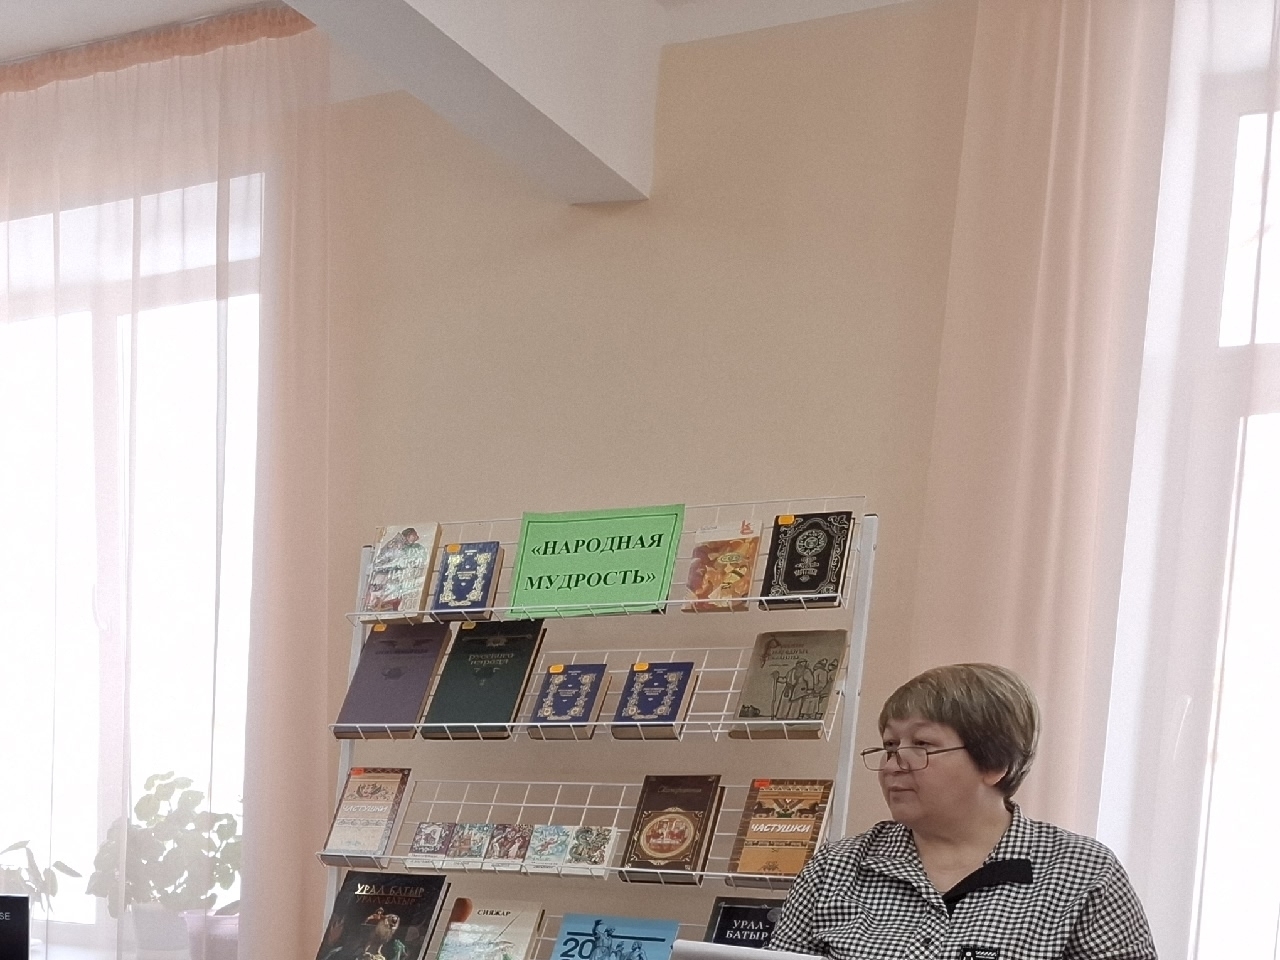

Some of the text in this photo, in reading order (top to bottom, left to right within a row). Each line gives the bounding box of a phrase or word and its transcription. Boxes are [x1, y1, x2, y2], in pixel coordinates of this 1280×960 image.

[531, 533, 664, 556] «НАРОДНАЯ
[523, 569, 656, 591] МУДРОСТЬ»
[750, 823, 812, 833] ЧАСТУШКИ
[732, 919, 770, 930] УРАЛ-
[725, 930, 769, 940] БАТЫР
[560, 937, 596, 960] 20
